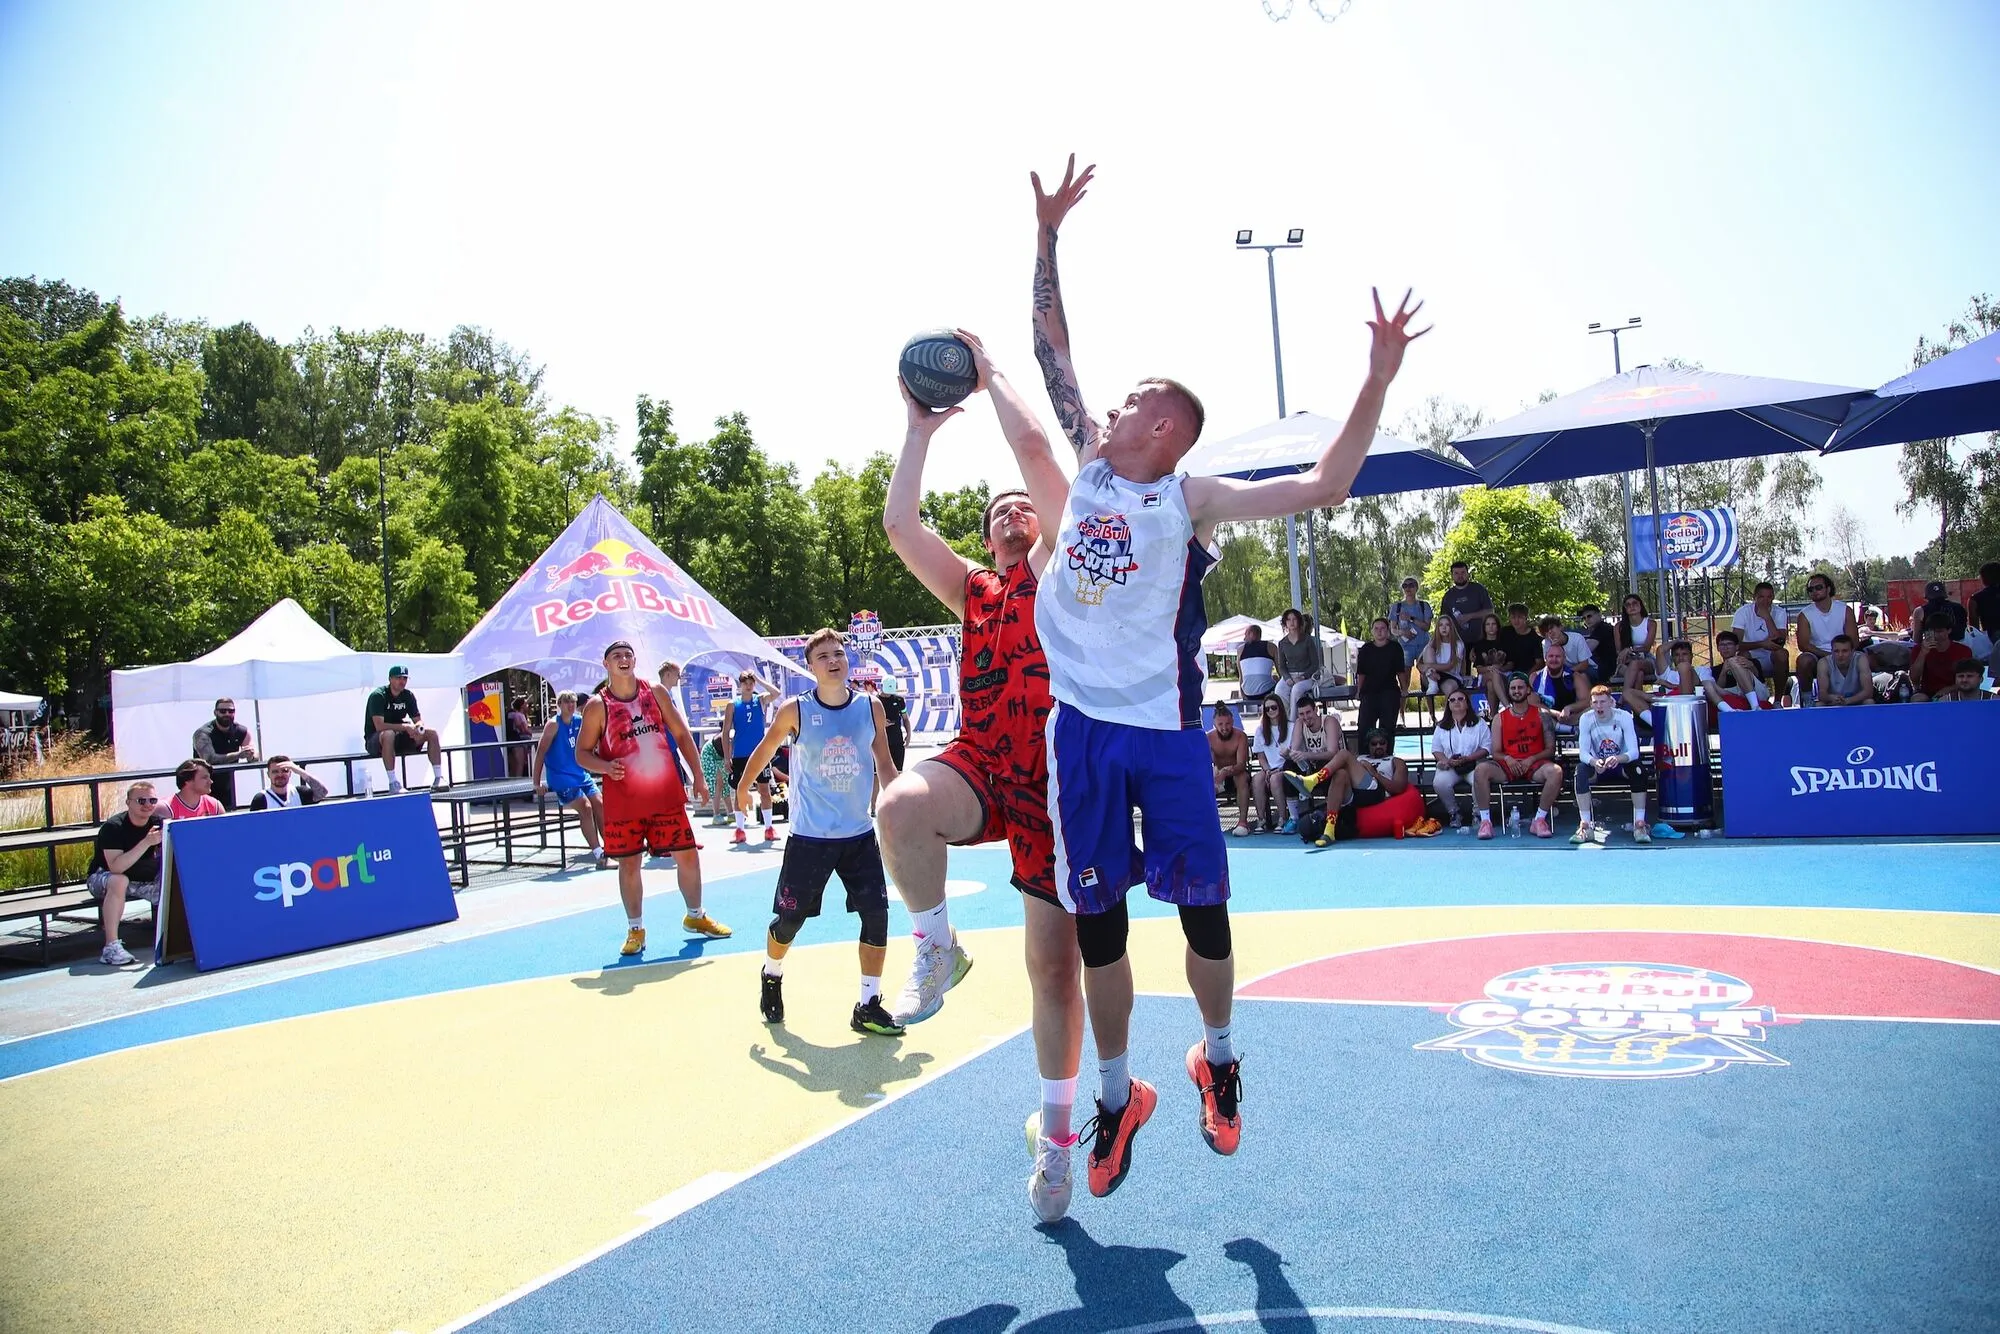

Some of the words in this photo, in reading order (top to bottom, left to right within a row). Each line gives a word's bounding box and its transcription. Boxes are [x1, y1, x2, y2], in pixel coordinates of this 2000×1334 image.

[1078, 521, 1102, 538] Red
[1102, 525, 1129, 541] Bull
[1664, 528, 1684, 540] Red
[1685, 526, 1704, 537] Bull
[1666, 542, 1704, 553] COURT
[535, 582, 626, 635] Red
[633, 584, 714, 626] Bull
[849, 624, 865, 633] Red
[866, 622, 882, 632] Bull
[850, 638, 882, 652] COURT
[484, 680, 499, 691] Bull
[746, 712, 753, 723] 2
[619, 722, 660, 740] betking
[1663, 743, 1688, 757] Bull
[1790, 761, 1938, 796] SPALDING
[253, 842, 376, 908] sport
[1503, 980, 1611, 996] Red
[1622, 982, 1728, 999] Bull
[1457, 1003, 1762, 1037] COURT
